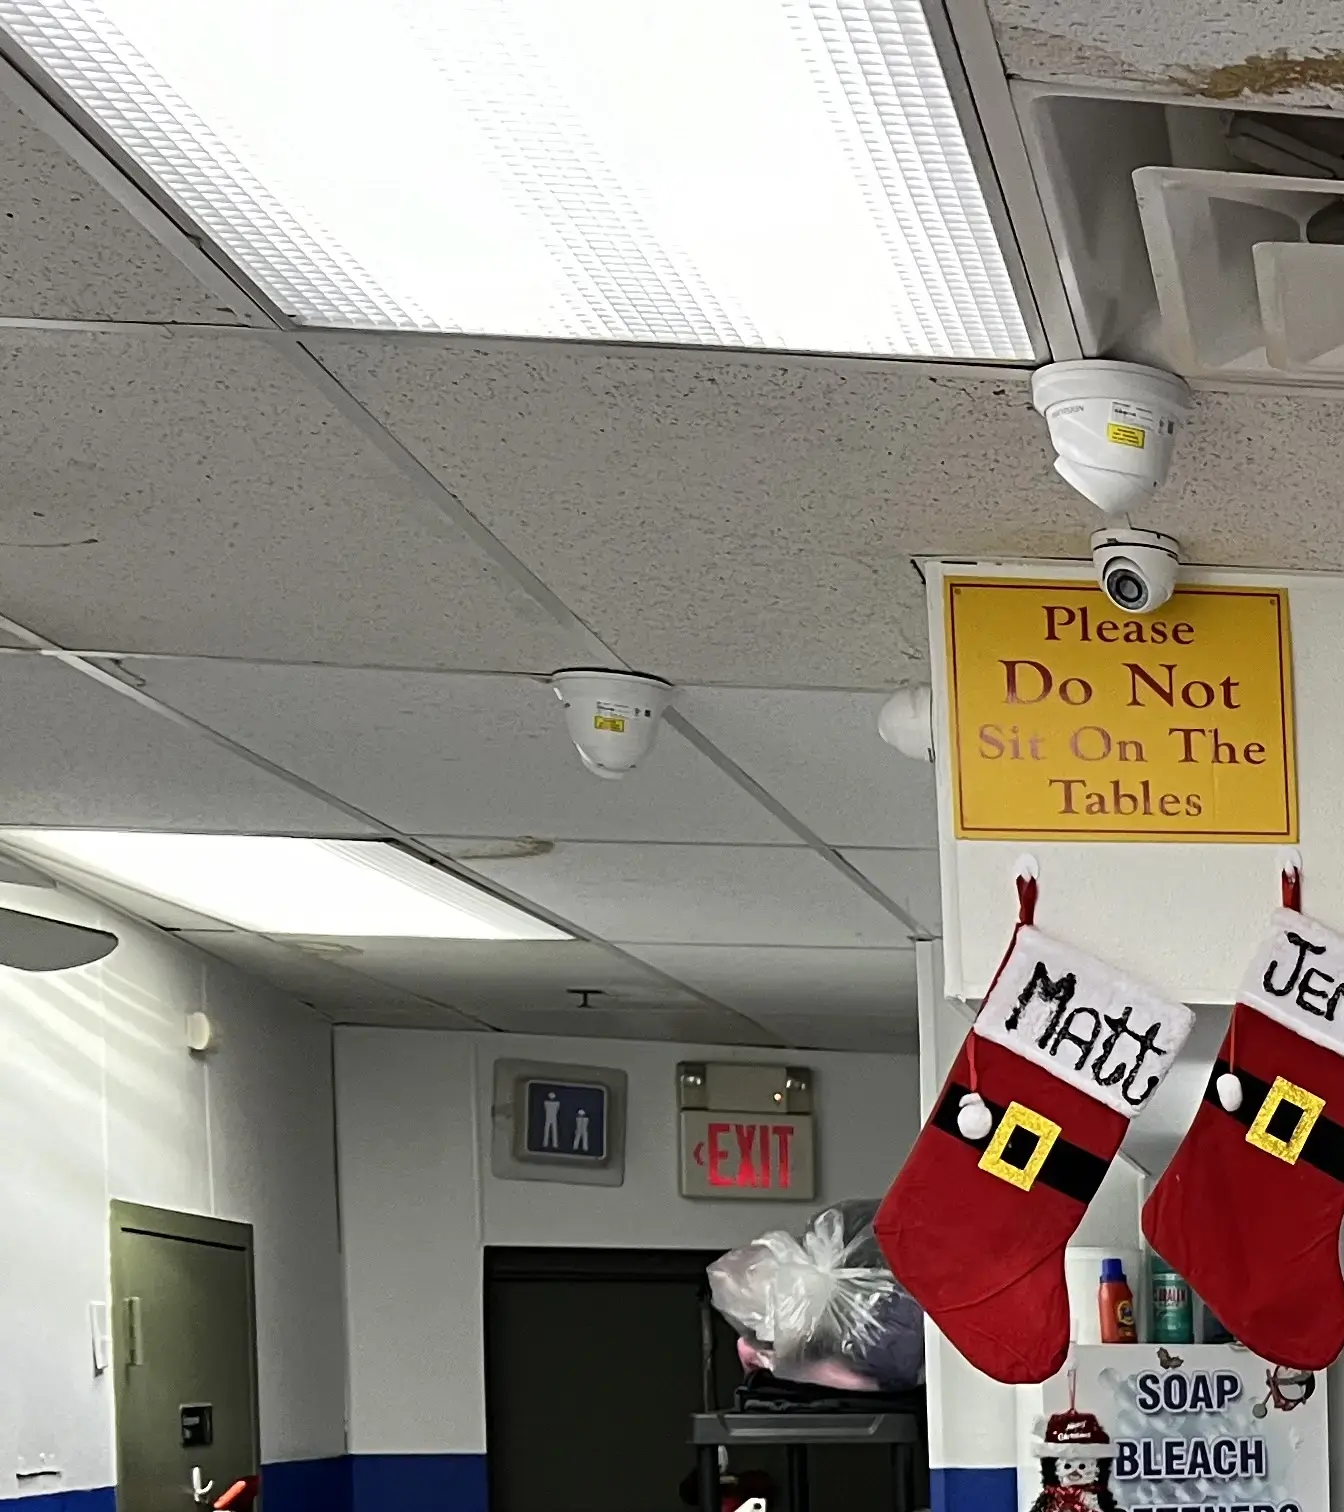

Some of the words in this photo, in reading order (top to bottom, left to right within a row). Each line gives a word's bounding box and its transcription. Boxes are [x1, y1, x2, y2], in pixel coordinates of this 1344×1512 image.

[1041, 605, 1195, 645] Please
[999, 659, 1093, 706] Do
[1121, 663, 1241, 709] Not
[978, 723, 1046, 761] Sit
[1069, 725, 1148, 763] On
[1168, 727, 1267, 765] The
[1048, 778, 1203, 817] Tables
[708, 1122, 795, 1189] EXIT
[1138, 1373, 1239, 1410] SOAP
[1115, 1440, 1264, 1476] BLEACH
